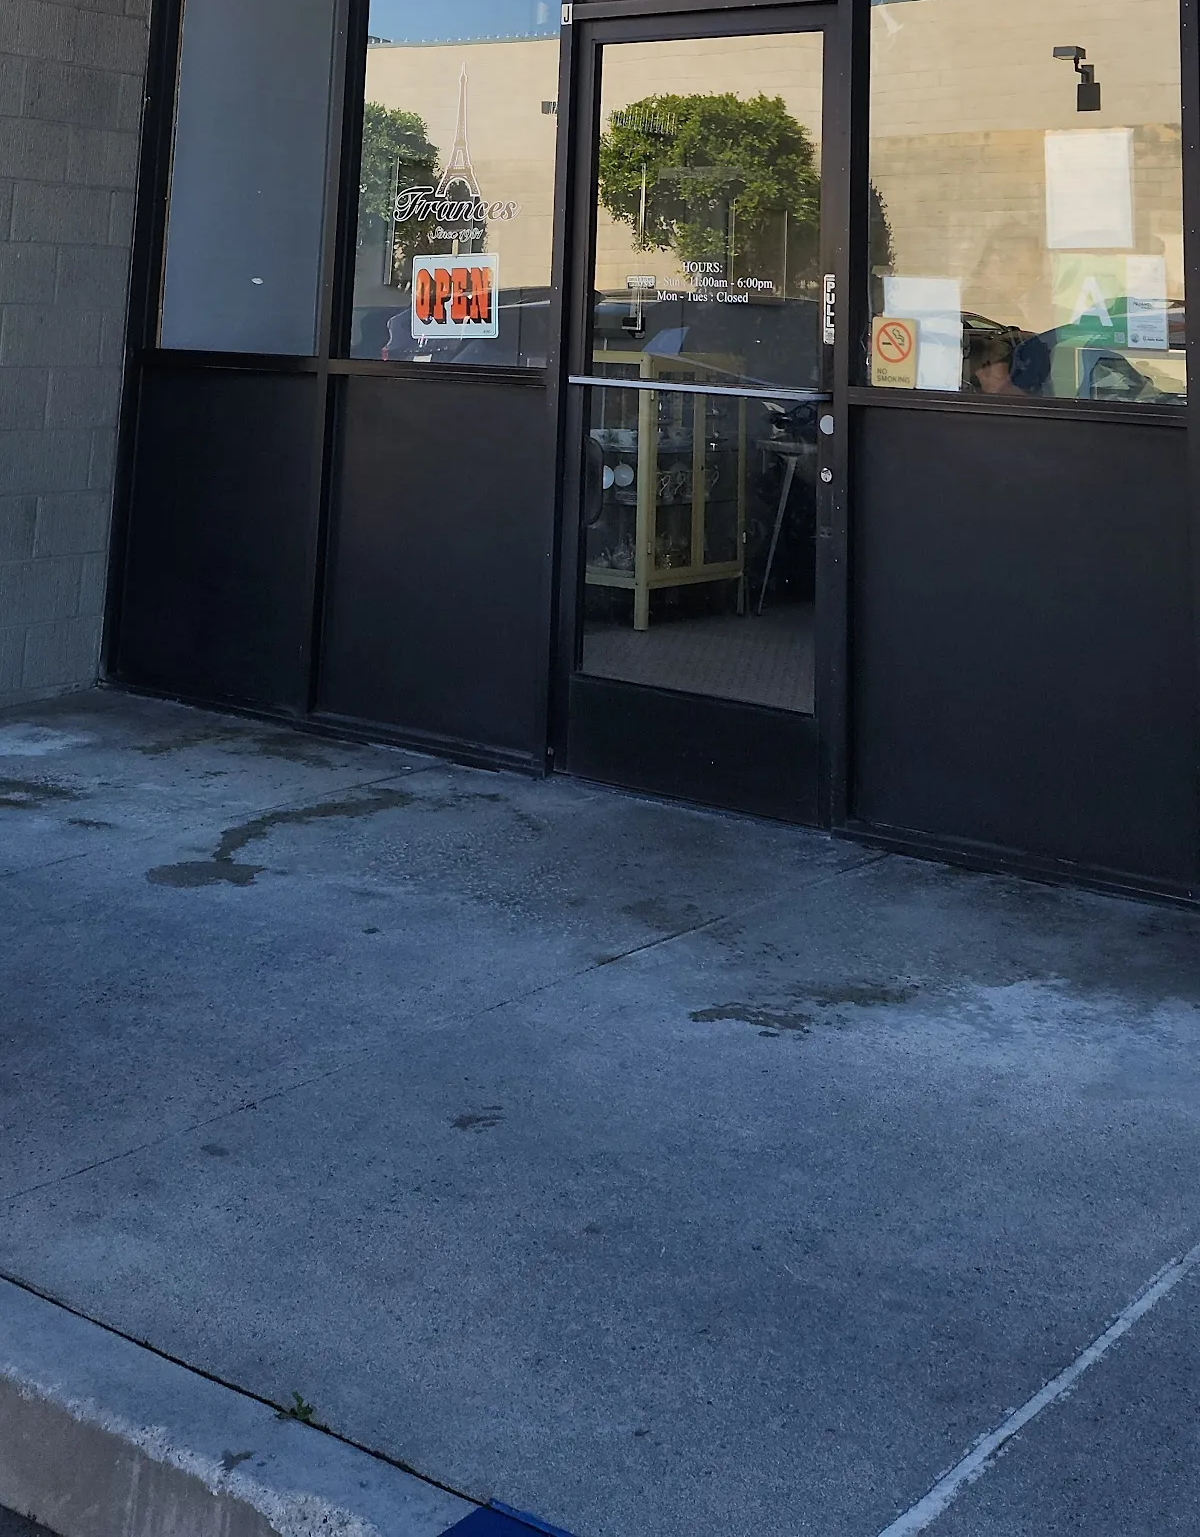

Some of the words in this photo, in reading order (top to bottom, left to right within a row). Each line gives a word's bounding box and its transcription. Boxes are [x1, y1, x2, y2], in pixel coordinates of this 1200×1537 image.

[563, 5, 570, 22] J
[393, 186, 522, 222] Frances
[430, 225, 459, 240] Since
[458, 227, 484, 243] 1981
[682, 262, 723, 273] HOURS:
[663, 277, 680, 287] Sun
[689, 277, 728, 288] 11:00am
[736, 277, 773, 291] 6:00pm
[415, 267, 493, 325] OPEN
[657, 291, 678, 301] Mon
[687, 291, 708, 302] Tues
[716, 292, 749, 303] Closed
[1070, 275, 1114, 327] A
[826, 281, 836, 329] PULL
[876, 375, 910, 384] SMOKING
